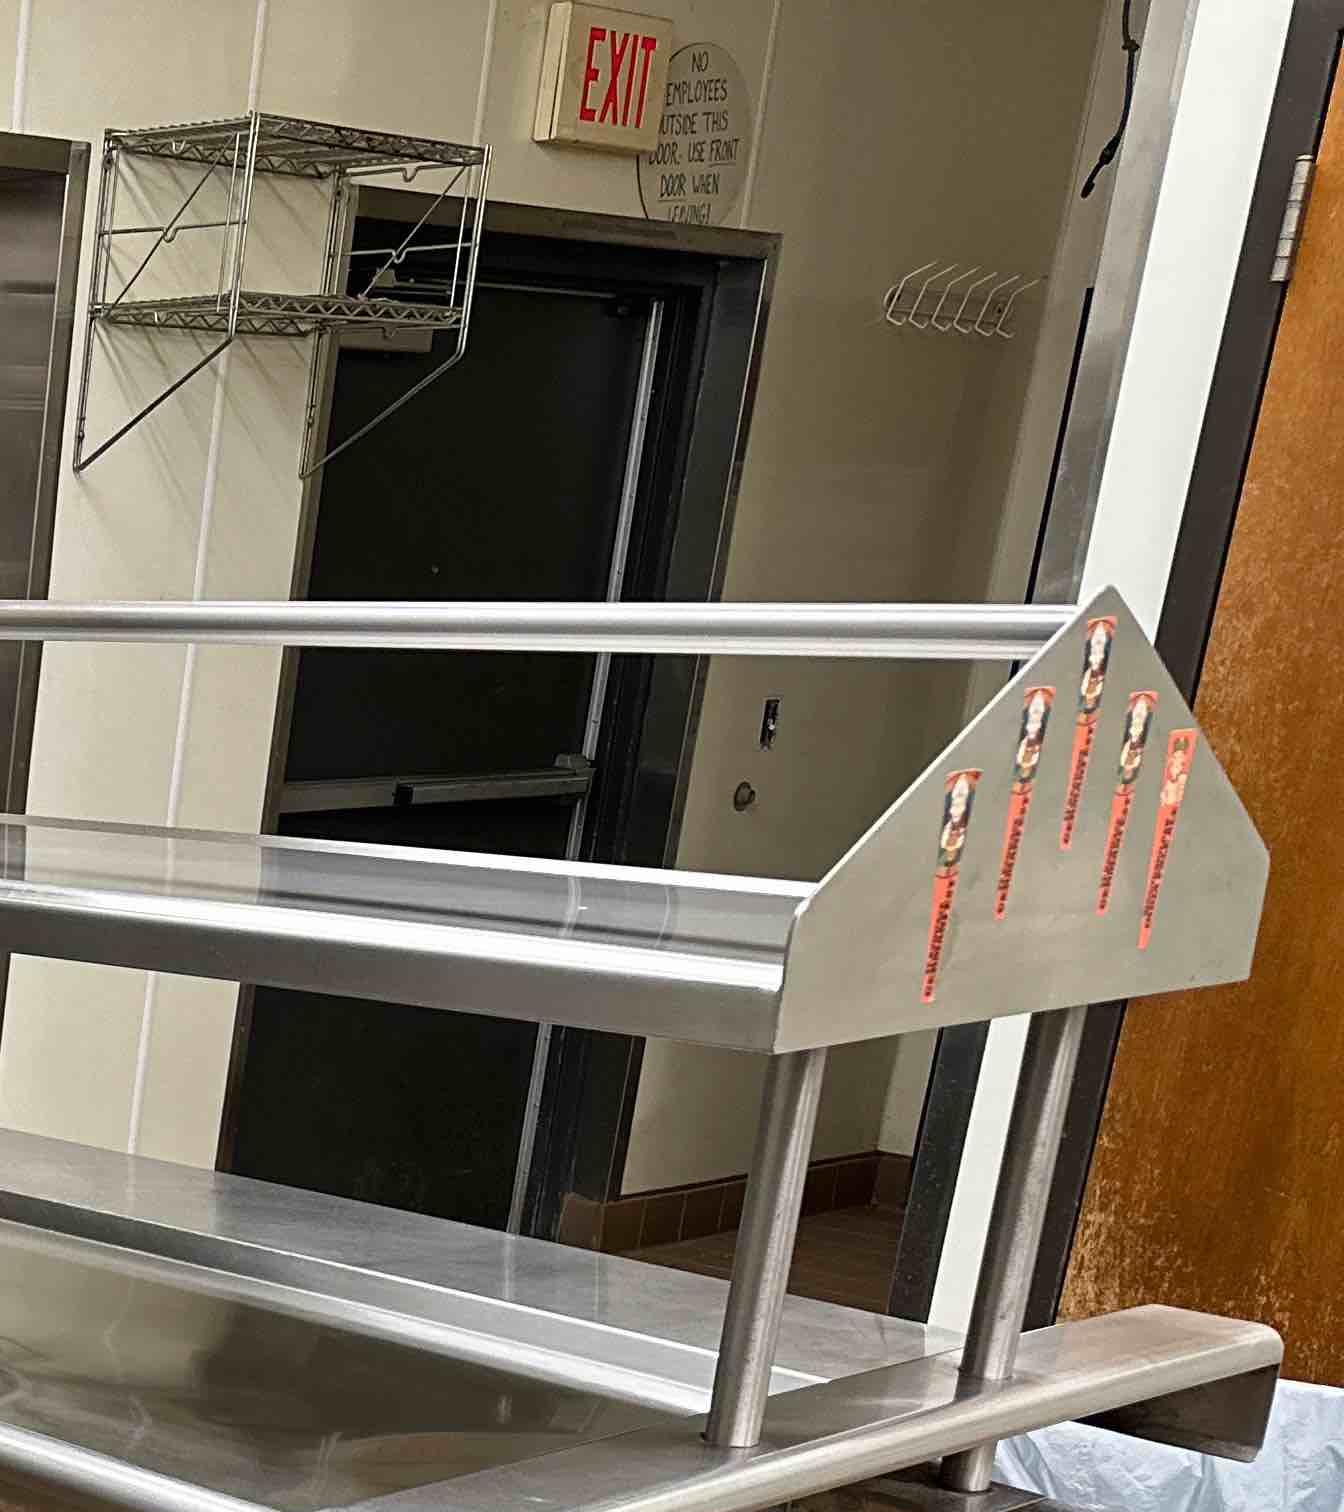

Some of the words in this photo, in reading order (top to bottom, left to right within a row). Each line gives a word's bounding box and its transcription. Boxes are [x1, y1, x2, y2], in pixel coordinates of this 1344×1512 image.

[691, 51, 709, 72] NO
[579, 27, 657, 128] EXIT
[666, 78, 728, 106] EMPLOYEES
[658, 111, 697, 136] UTSIDE
[702, 110, 729, 133] THIS
[688, 141, 706, 162] USE
[711, 138, 739, 161] FRONT
[660, 172, 687, 197] DOOR
[692, 172, 720, 194] WHEN
